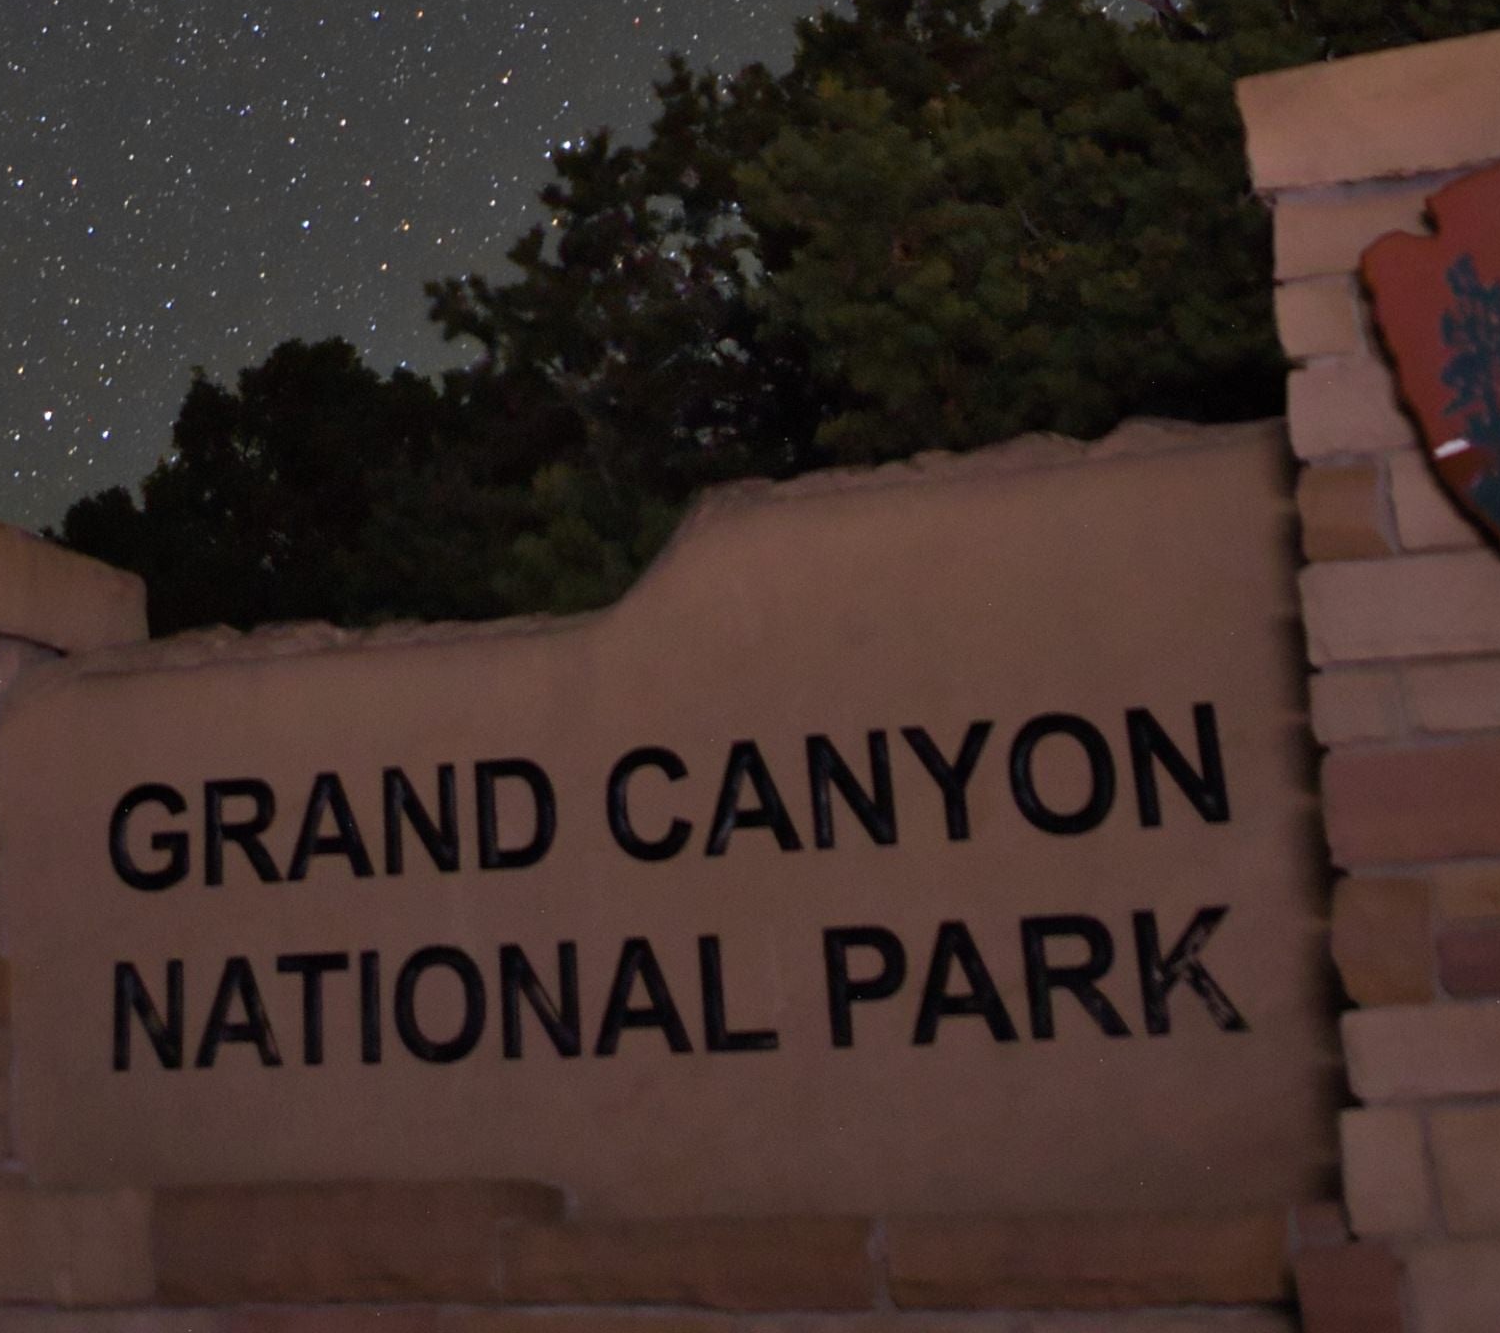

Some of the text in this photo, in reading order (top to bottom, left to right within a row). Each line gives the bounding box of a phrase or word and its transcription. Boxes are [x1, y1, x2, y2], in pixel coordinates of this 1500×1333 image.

[107, 702, 1232, 893] GRAND CANYON
[110, 905, 1249, 1072] NATIONAL PARK
